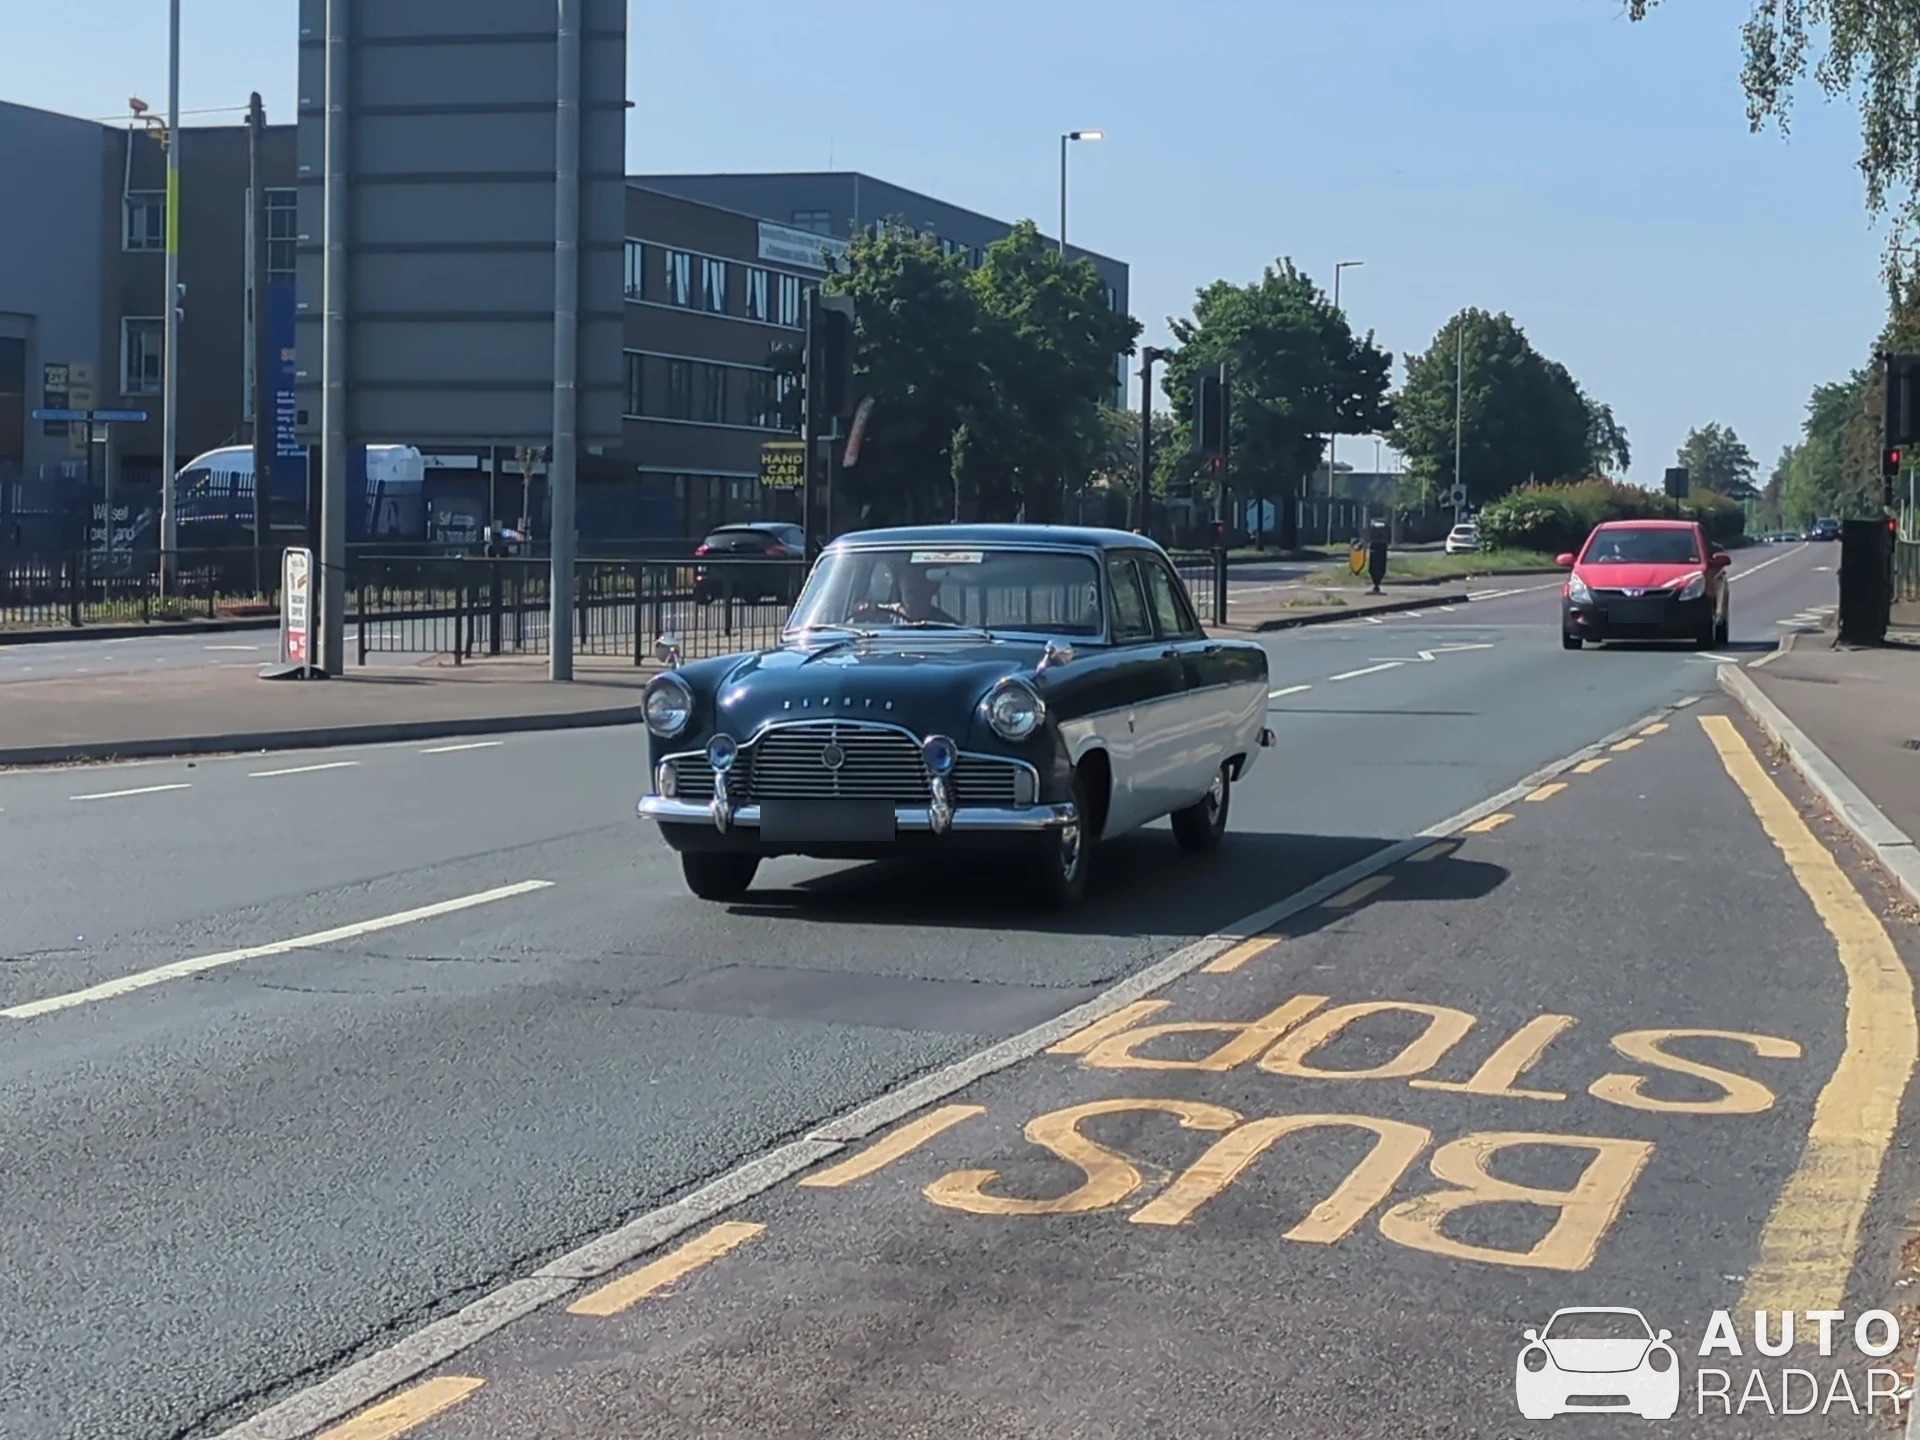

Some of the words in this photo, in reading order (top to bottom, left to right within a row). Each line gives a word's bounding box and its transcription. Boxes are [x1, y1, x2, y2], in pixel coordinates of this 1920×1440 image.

[761, 454, 803, 464] HAND
[767, 465, 797, 475] CAR
[760, 475, 804, 486] WASH
[1082, 995, 1801, 1114] STOP
[922, 1098, 1656, 1271] BUS
